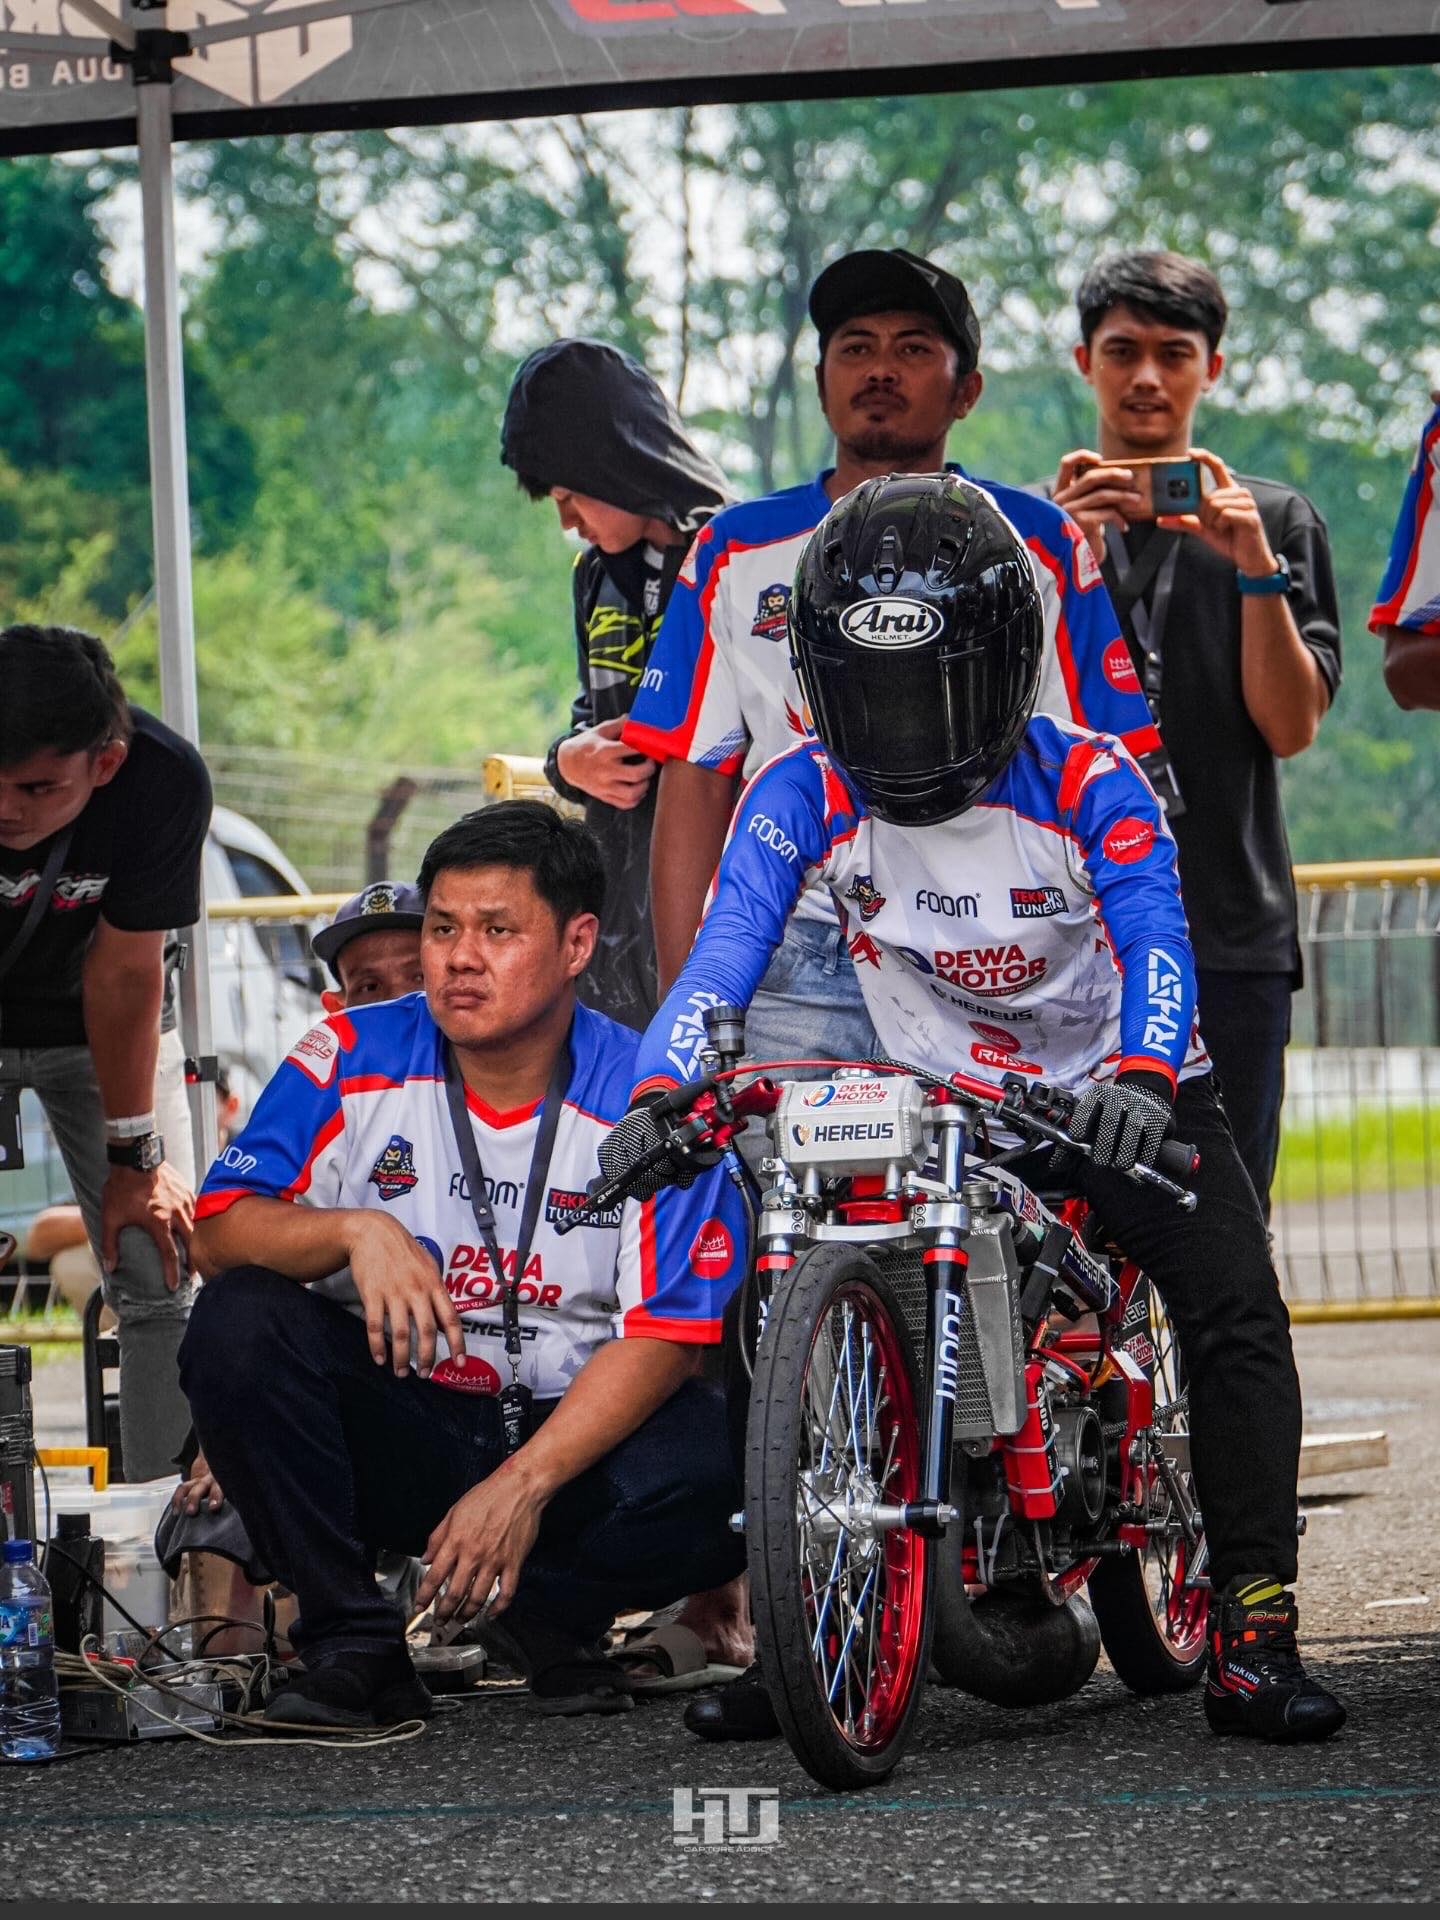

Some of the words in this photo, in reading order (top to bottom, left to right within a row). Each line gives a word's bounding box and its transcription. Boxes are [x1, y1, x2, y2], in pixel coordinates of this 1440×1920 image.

[847, 605, 929, 632] Arai
[934, 944, 1026, 968] DEWA
[935, 958, 1048, 989] MOTOR
[951, 998, 1034, 1021] HEREUS
[835, 1090, 888, 1100] MOTOR
[839, 1083, 881, 1092] DEWA
[814, 1123, 894, 1142] HEREUS
[548, 1206, 599, 1225] TUER
[449, 1245, 543, 1281] DEWA
